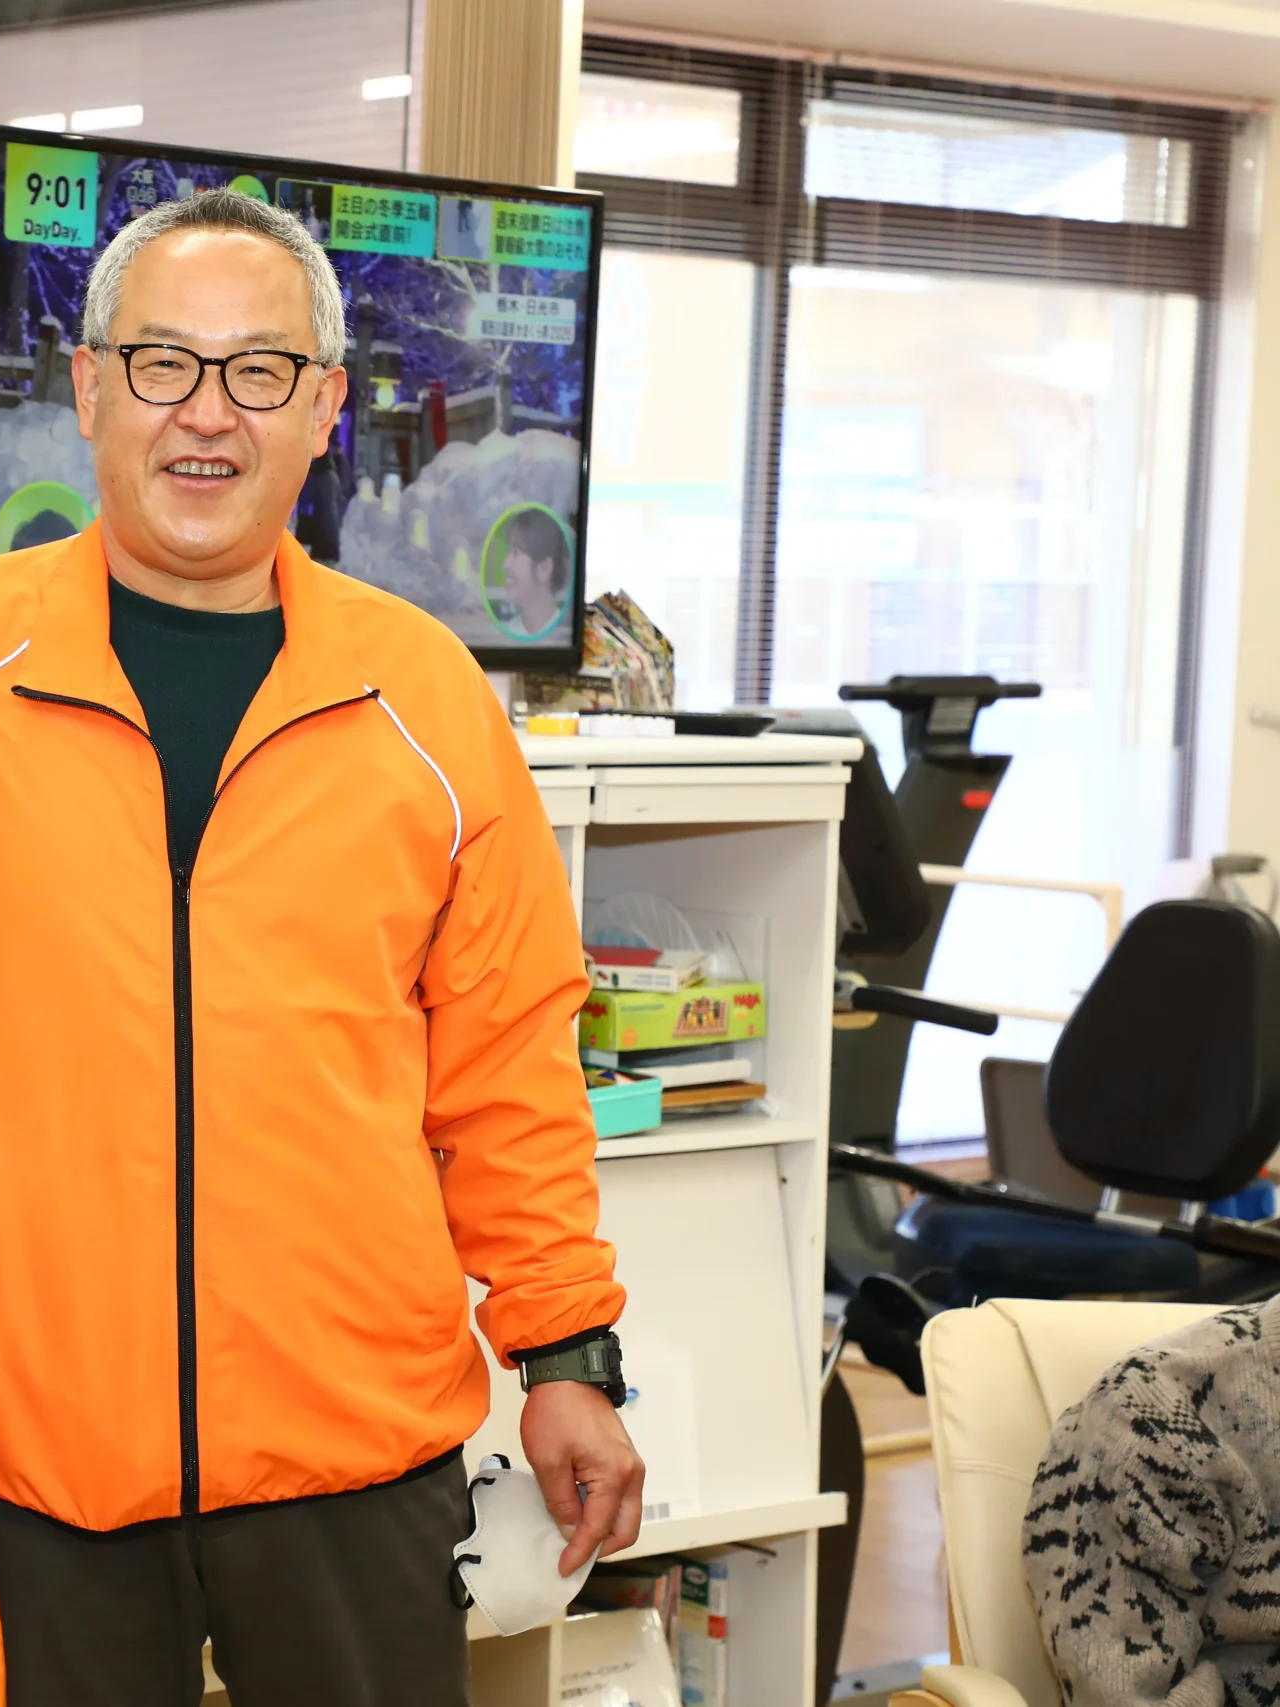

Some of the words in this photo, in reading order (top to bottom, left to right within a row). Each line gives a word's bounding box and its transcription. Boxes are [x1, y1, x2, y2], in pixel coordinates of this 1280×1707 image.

[26, 172, 87, 211] 9:01
[336, 194, 431, 222] 注目の冬季五輪
[23, 218, 83, 242] DayDay.
